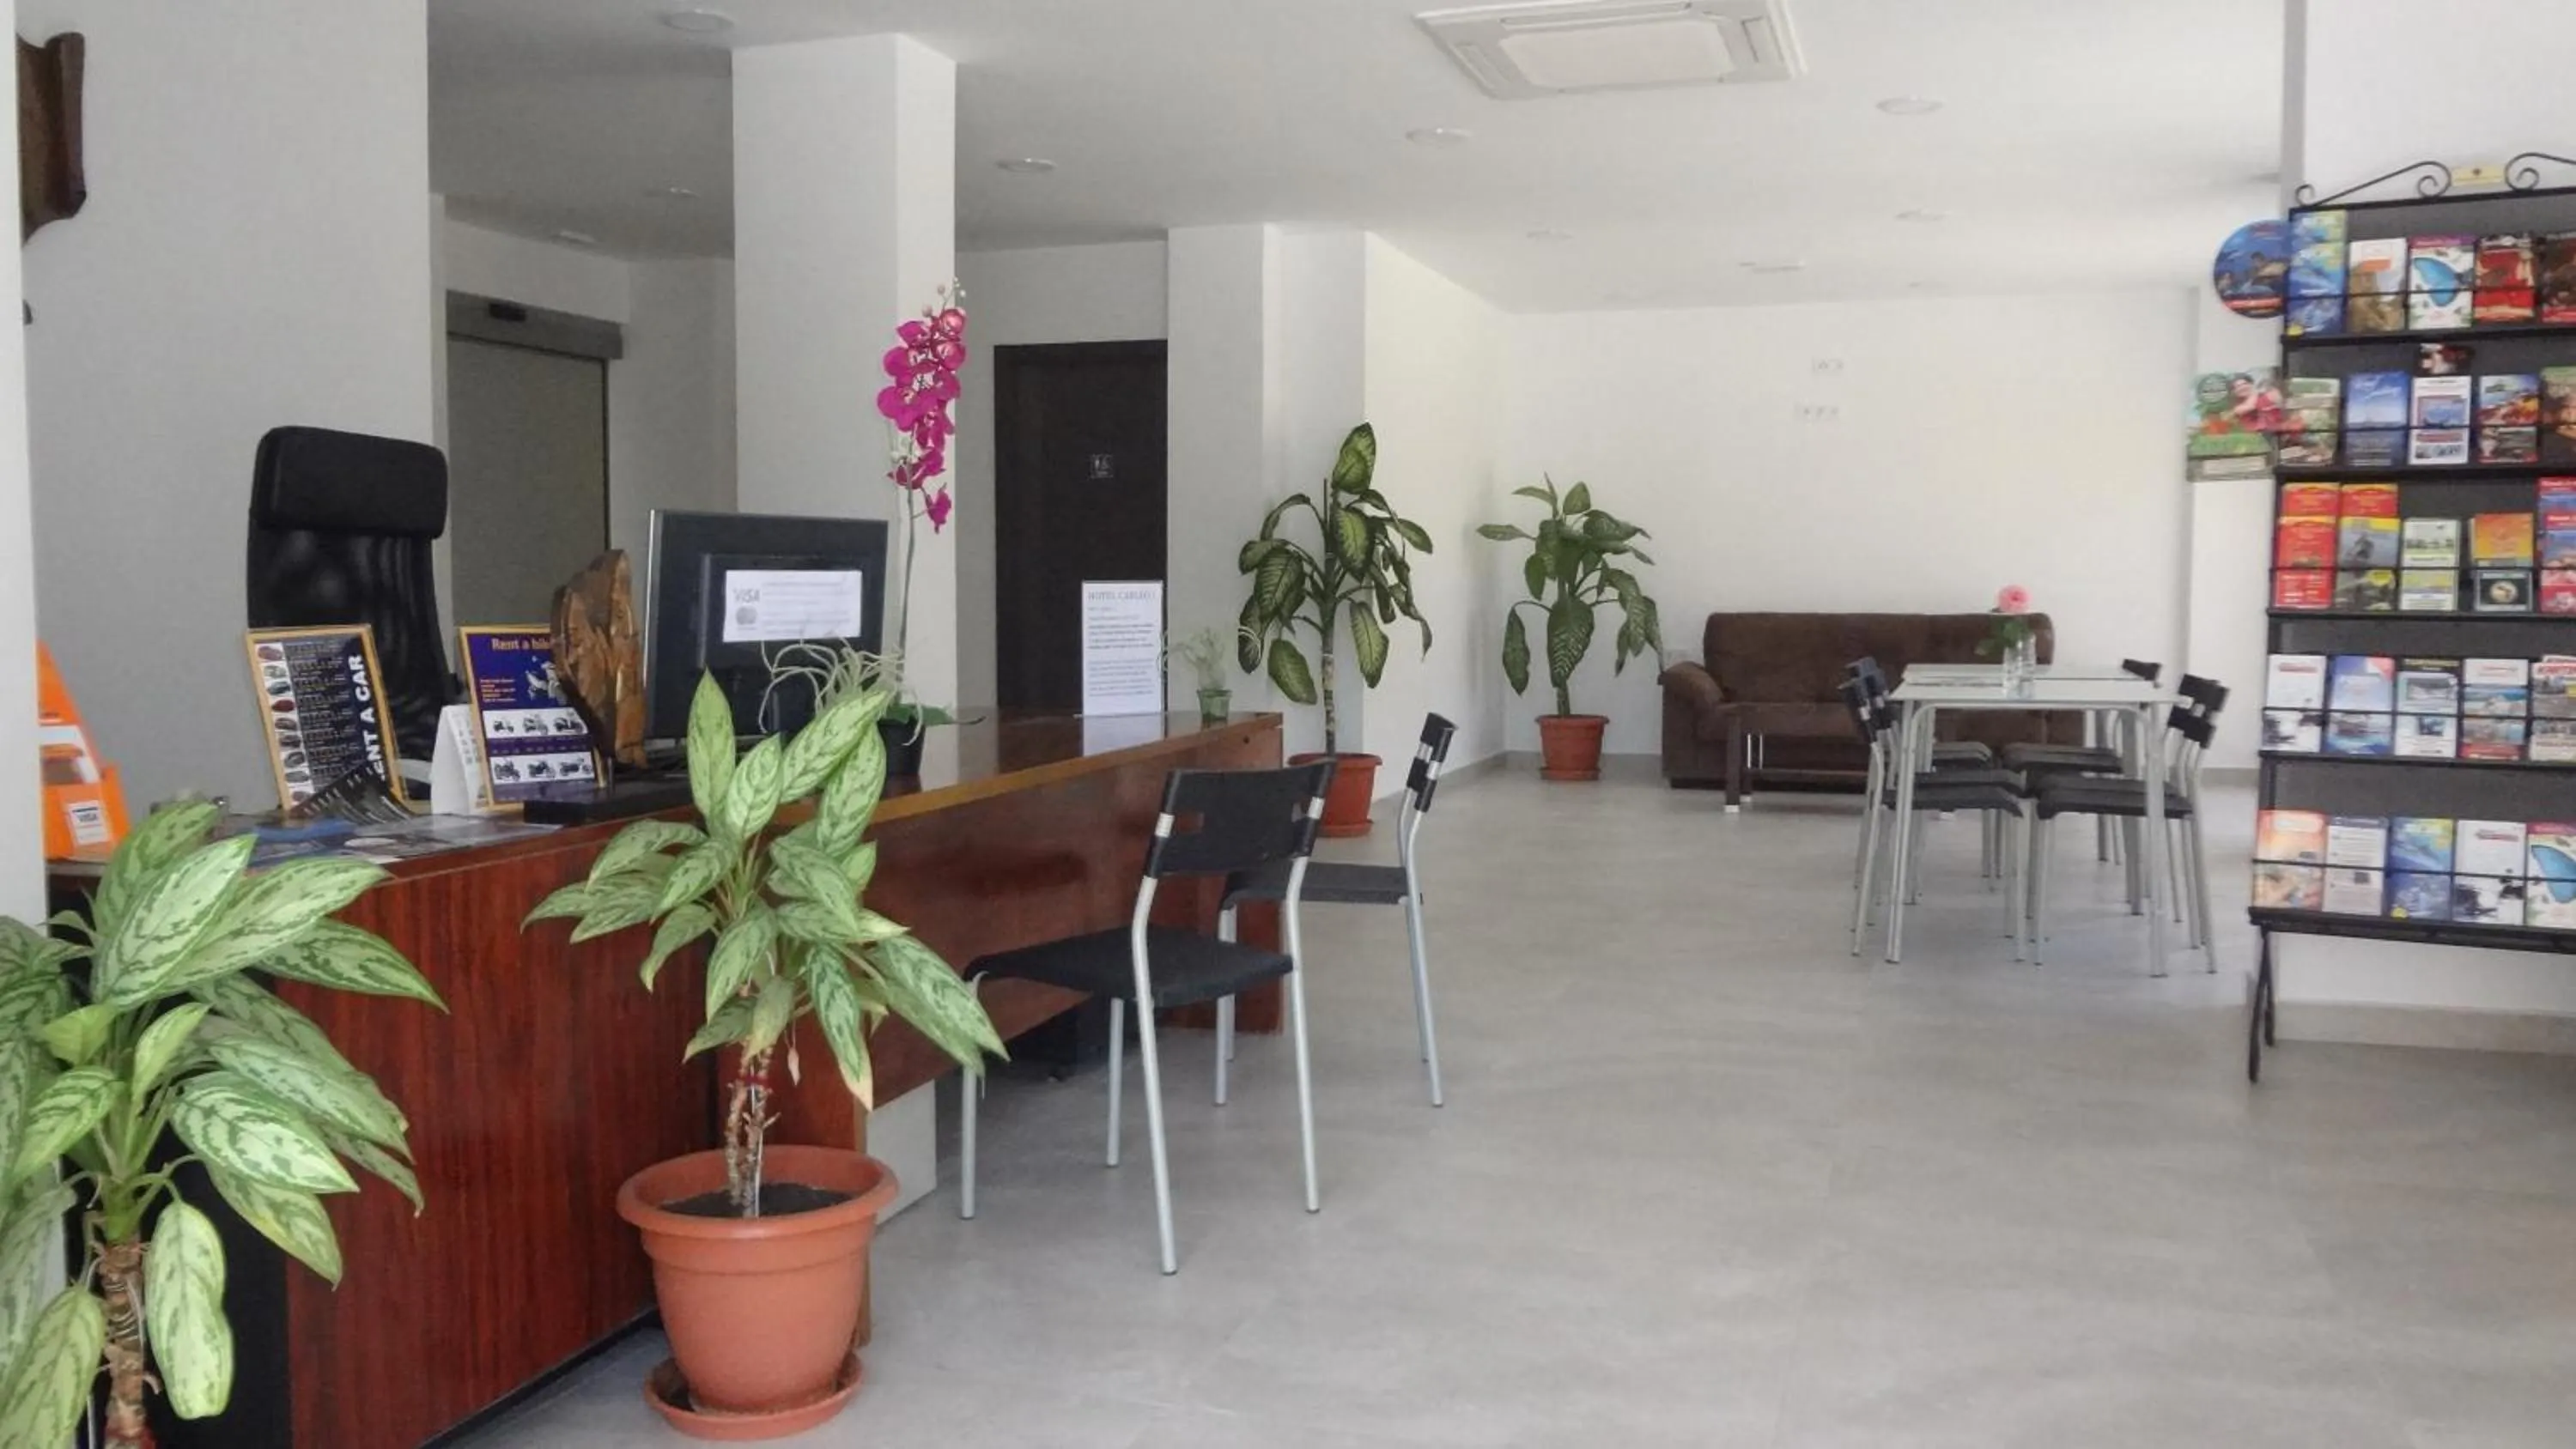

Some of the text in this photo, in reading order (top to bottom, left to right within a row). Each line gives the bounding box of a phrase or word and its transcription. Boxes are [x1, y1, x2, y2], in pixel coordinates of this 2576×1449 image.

[732, 588, 760, 603] VISA
[492, 638, 550, 650] Rent a bik
[348, 654, 386, 781] ENT A CAR
